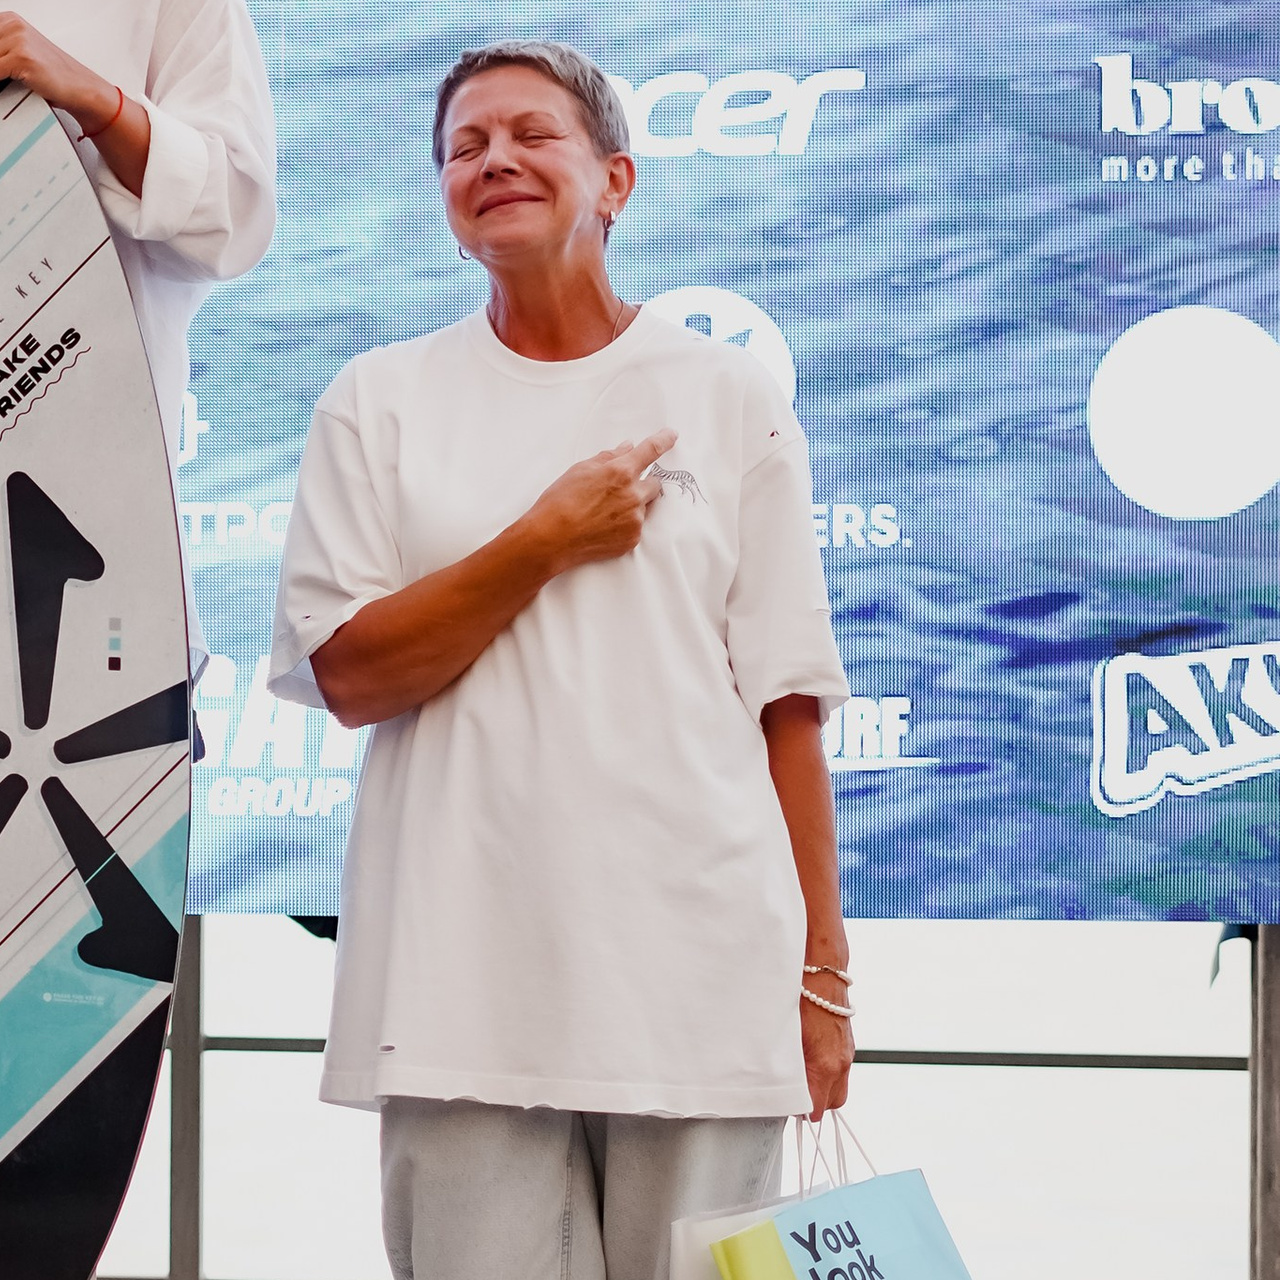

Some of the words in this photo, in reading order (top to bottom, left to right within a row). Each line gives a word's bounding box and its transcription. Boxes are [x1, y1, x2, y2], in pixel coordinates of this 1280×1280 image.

[608, 70, 867, 157] cer
[1093, 53, 1280, 135] bro
[1101, 154, 1204, 182] more
[15, 257, 53, 299] KEY
[207, 776, 353, 817] GROUP
[789, 1220, 861, 1264] You
